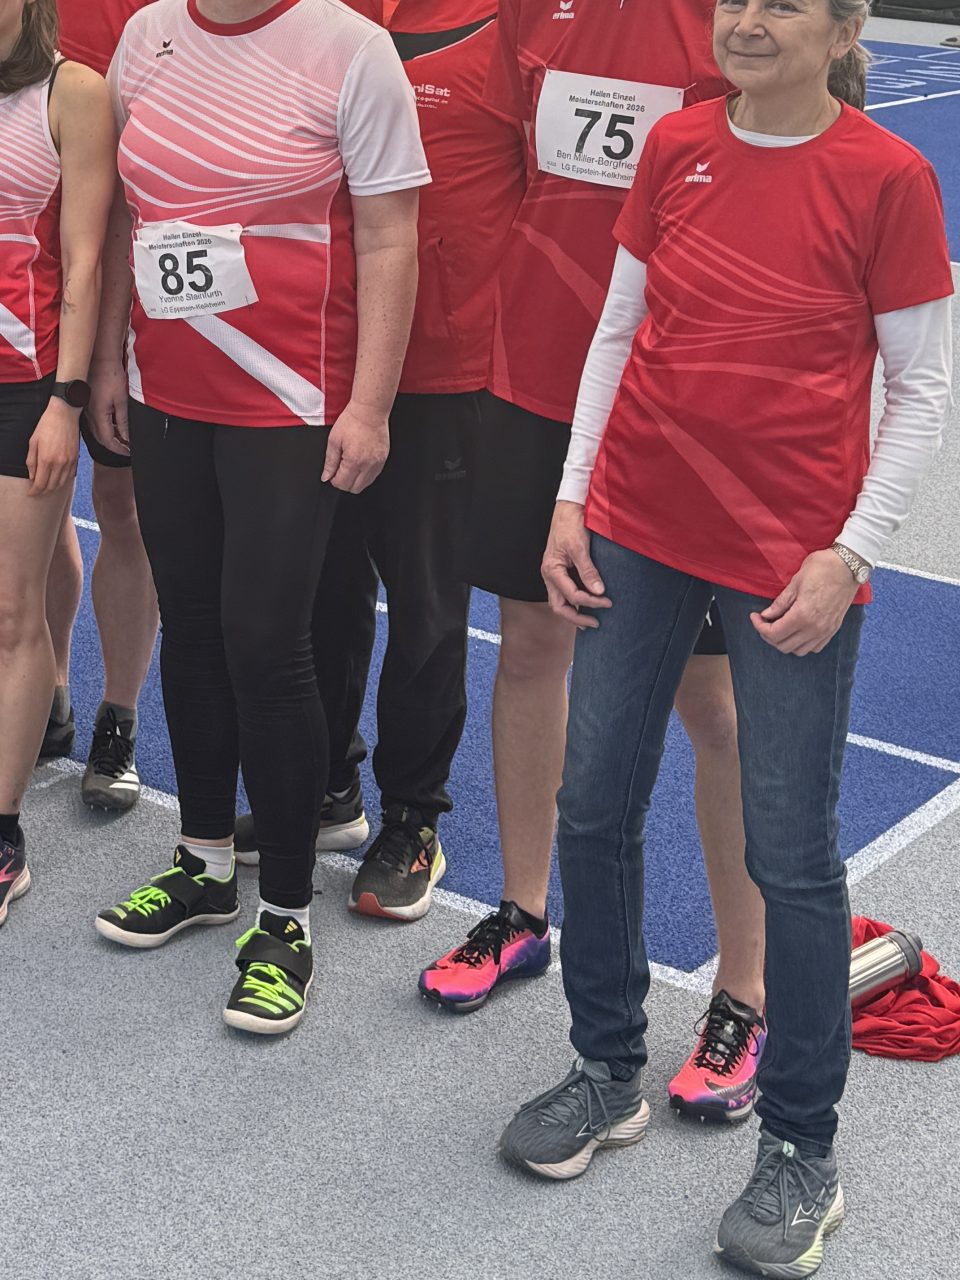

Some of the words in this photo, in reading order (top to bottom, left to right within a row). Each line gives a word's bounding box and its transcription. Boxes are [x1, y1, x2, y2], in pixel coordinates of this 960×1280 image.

[552, 11, 575, 20] erima
[413, 84, 450, 96] niSat
[590, 89, 610, 98] Hallen
[613, 92, 635, 102] Einzel
[569, 95, 624, 109] Meisterschaften
[626, 104, 645, 112] 2026
[574, 108, 636, 160] 75
[562, 163, 570, 171] LG
[685, 174, 712, 183] erima
[158, 249, 213, 295] 85
